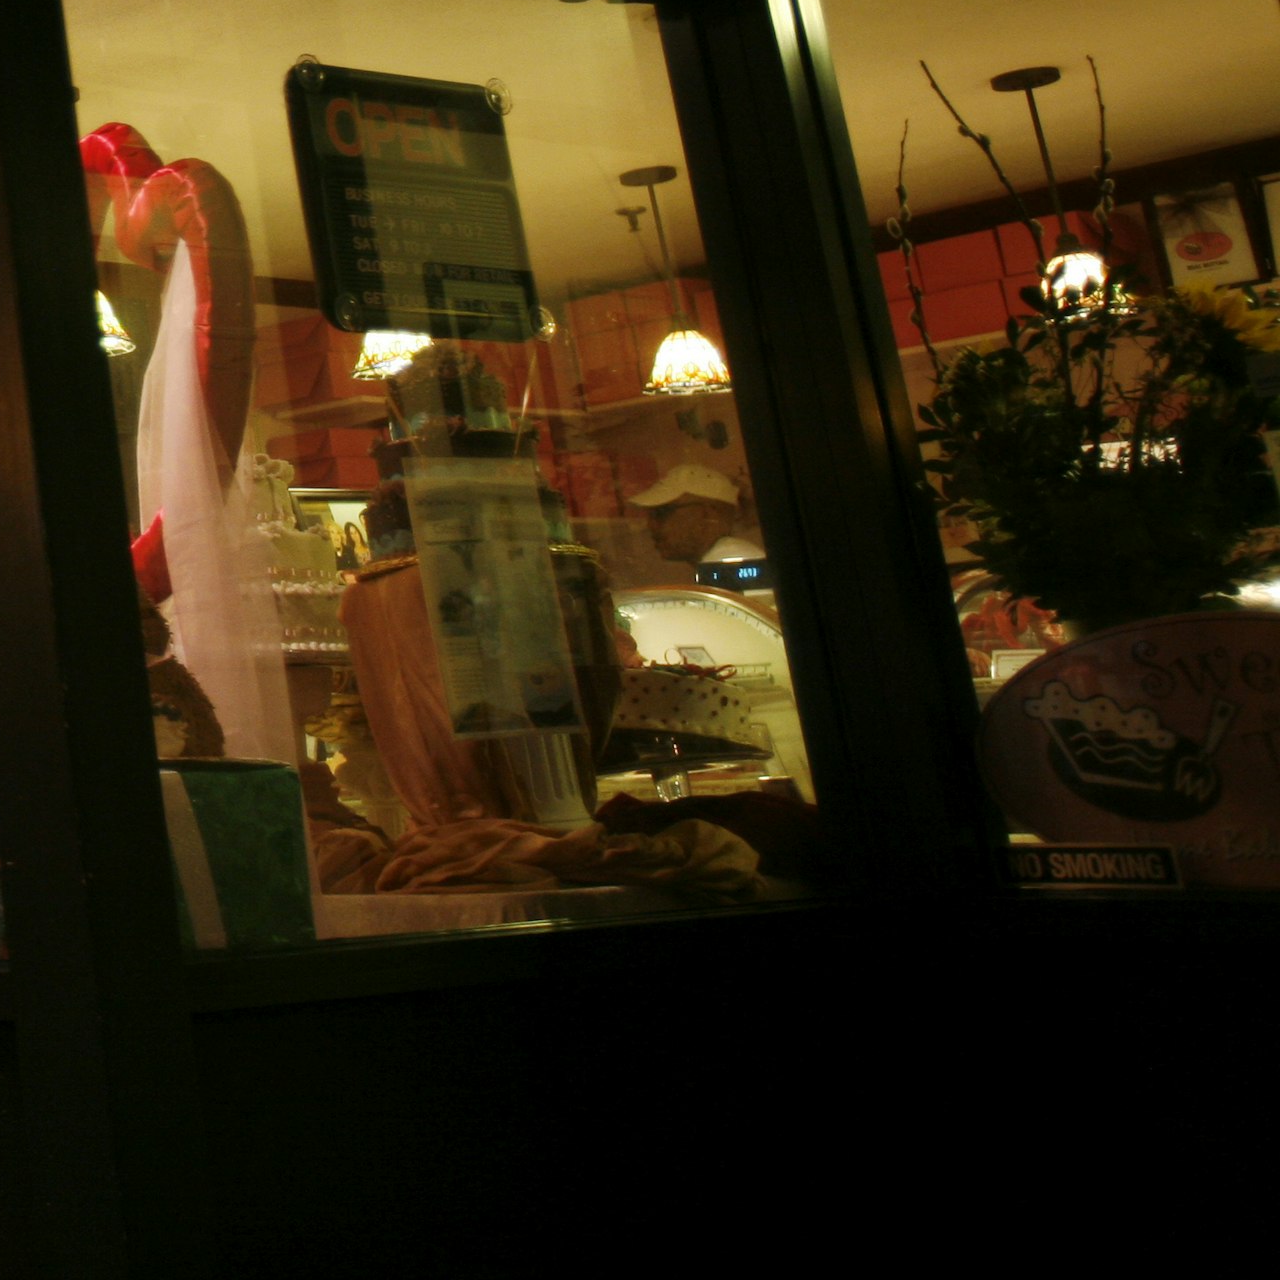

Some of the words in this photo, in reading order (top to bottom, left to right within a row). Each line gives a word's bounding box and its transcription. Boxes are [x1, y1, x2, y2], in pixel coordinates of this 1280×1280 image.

[326, 97, 467, 166] OPEN
[1131, 638, 1280, 699] Swe
[1048, 852, 1167, 880] SMOKING
